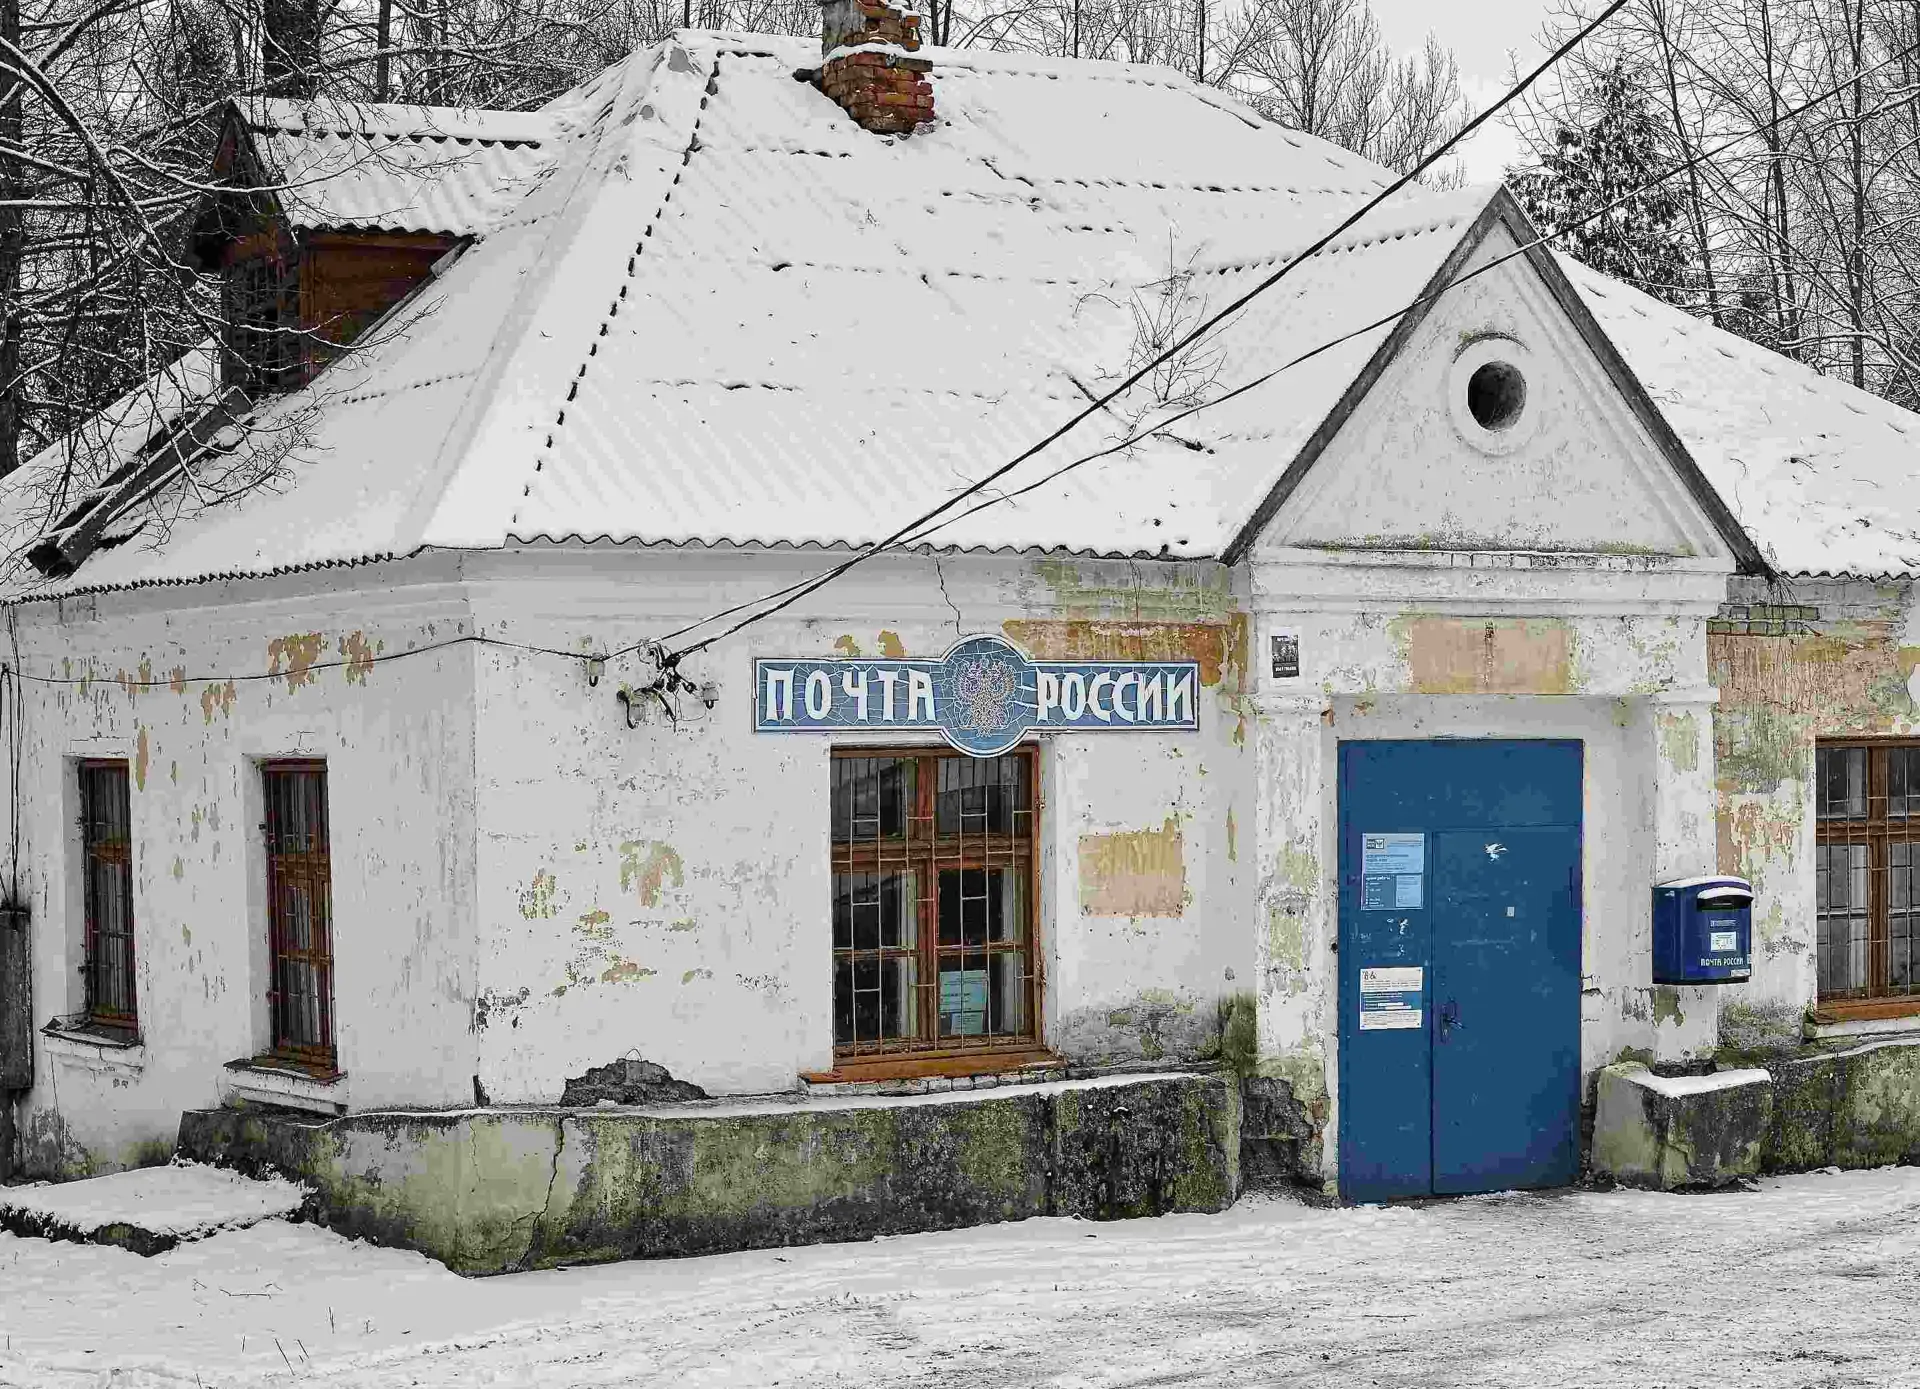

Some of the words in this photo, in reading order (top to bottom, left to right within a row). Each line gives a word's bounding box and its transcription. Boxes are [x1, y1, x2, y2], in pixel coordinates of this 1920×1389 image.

[764, 664, 937, 723] ПОЧТА
[1035, 667, 1197, 725] РОССИИ
[1700, 957, 1722, 967] ПОЧТА
[1723, 957, 1744, 966] РОССИИ
